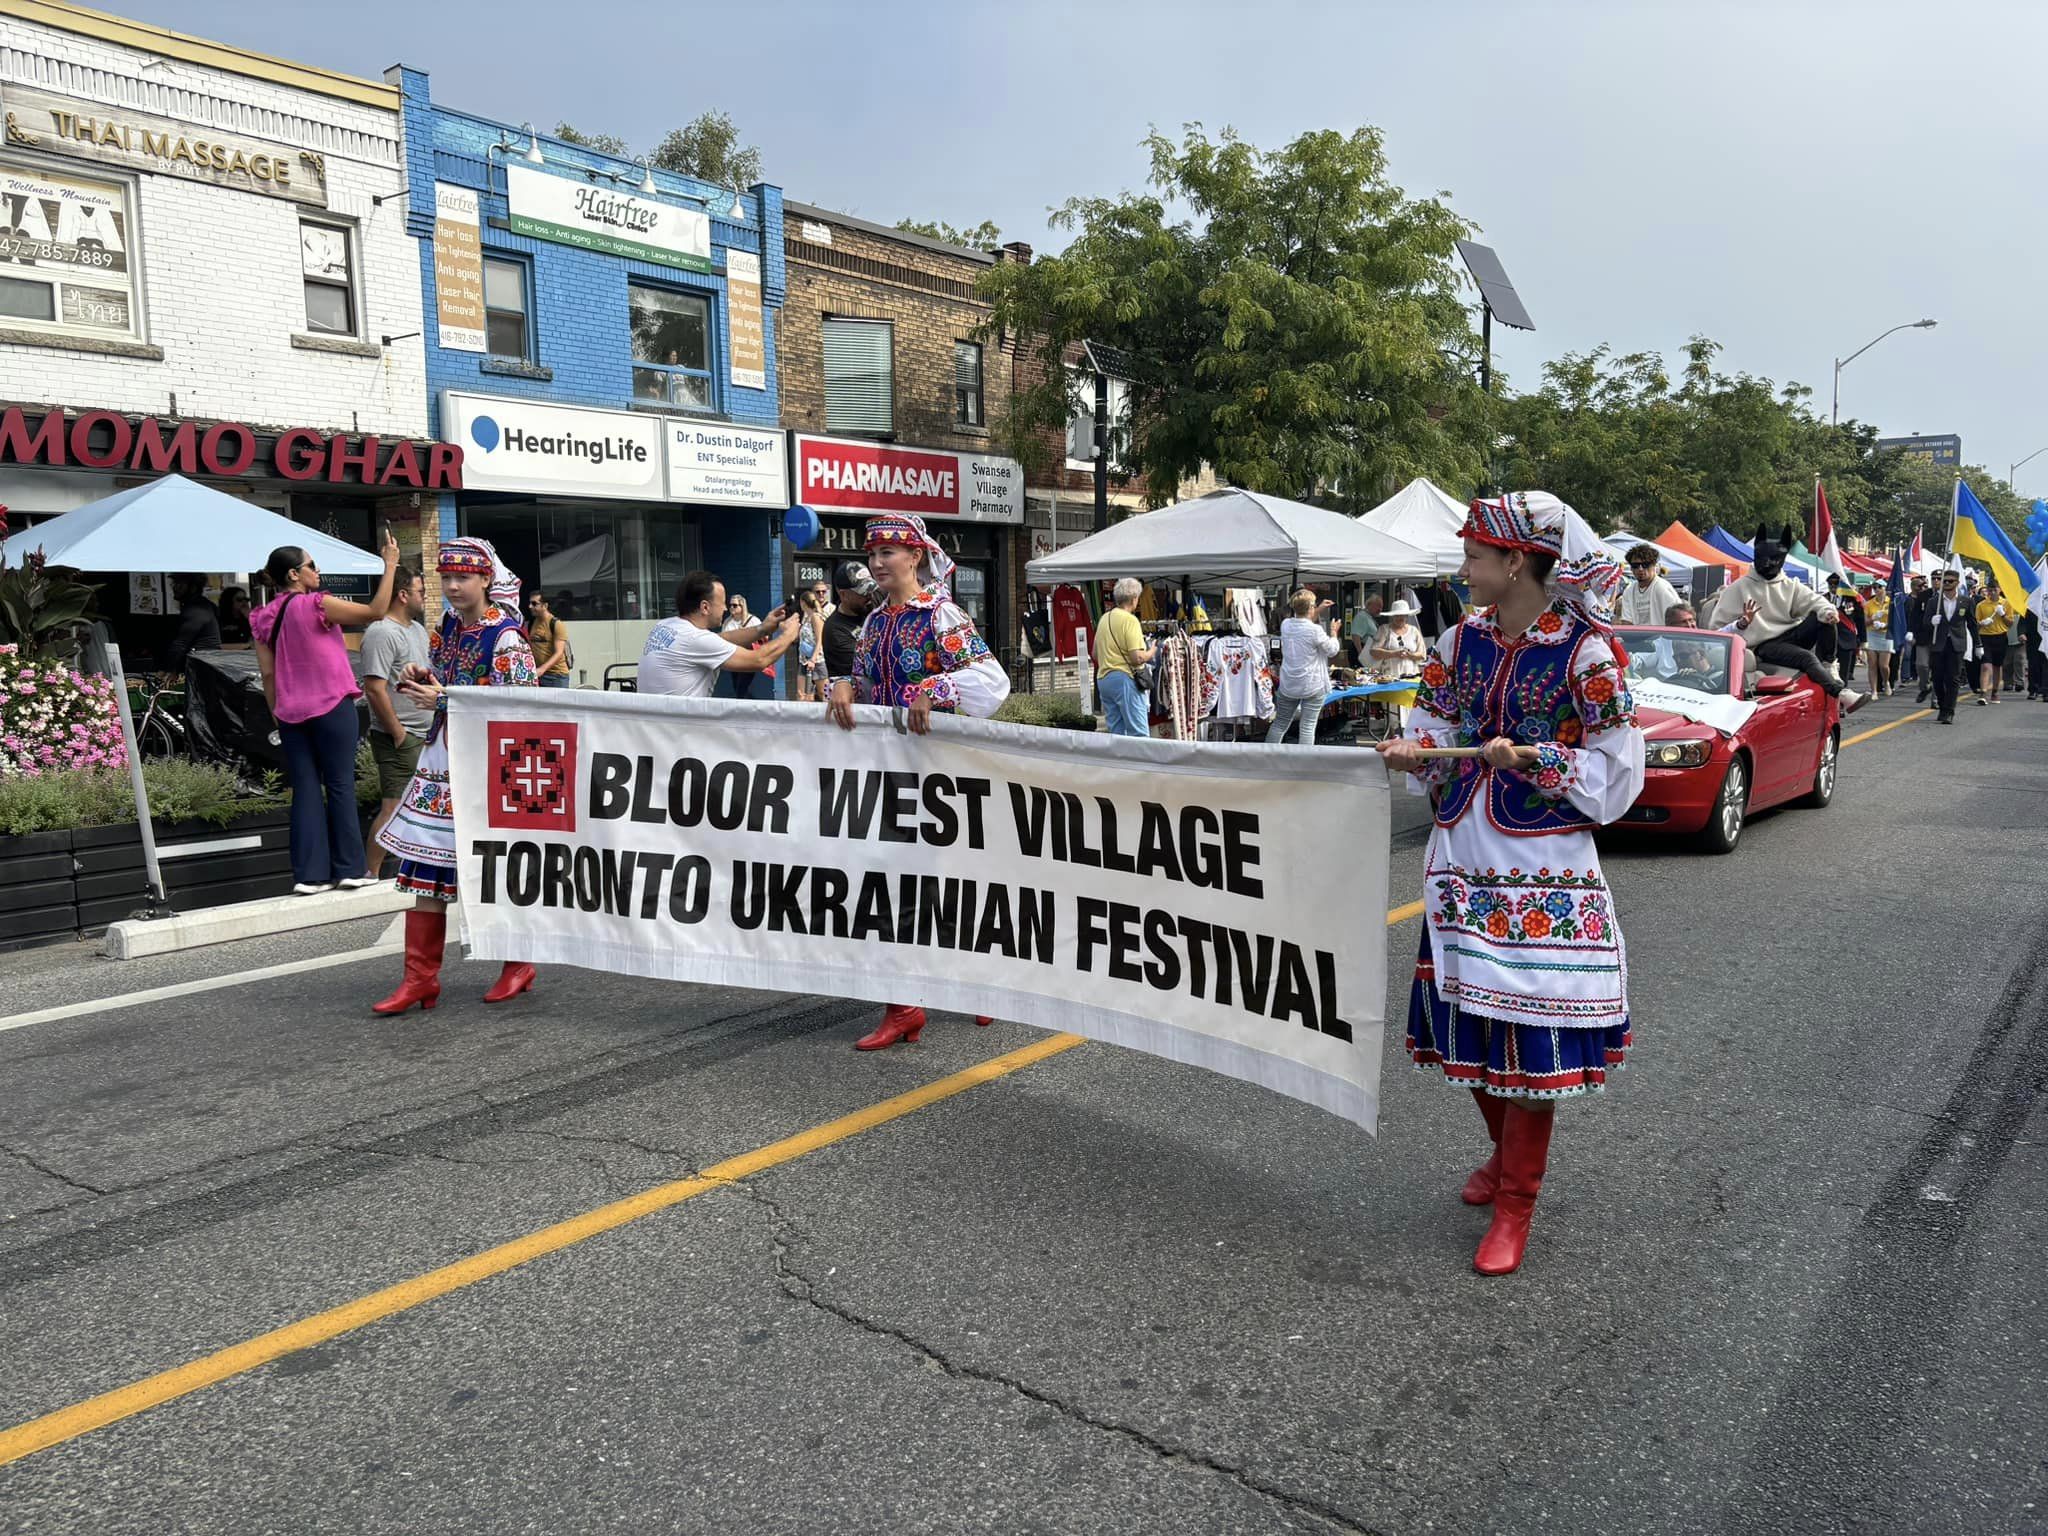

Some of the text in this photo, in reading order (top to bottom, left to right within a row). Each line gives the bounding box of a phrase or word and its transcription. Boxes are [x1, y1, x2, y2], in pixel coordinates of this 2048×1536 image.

[49, 109, 290, 184] THAI MASSAGE
[157, 159, 201, 176] BY RMT
[7, 179, 111, 207] Wellness Mountain
[575, 188, 658, 227] Hairfree
[582, 210, 602, 222] Laser
[437, 223, 474, 242] Hair loss
[434, 241, 448, 254] Skin
[518, 220, 706, 267] Hair loss Anti aging Skin tightening Laser hair removal
[437, 261, 480, 284] Anti aging
[439, 282, 481, 301] Laser Hair
[442, 301, 477, 317] Removal
[0, 406, 465, 490] MOMO GHAR
[503, 426, 647, 465] HearingLife
[677, 430, 774, 453] Dr. Dustin Dalgorf
[697, 452, 757, 466] ENT Specialist
[807, 457, 954, 499] PHARMASAVE
[971, 462, 1011, 479] Swansea
[704, 475, 752, 488] Otolaryngology
[976, 480, 1008, 498] Village
[693, 485, 764, 498] Head and Neck Surgery
[970, 499, 1013, 517] Pharmacy
[801, 567, 824, 581] 2388
[589, 751, 1264, 899] BLOOR WEST VILLAGE
[472, 840, 1353, 1044] TORONTO UKRAINIAN FESTIVAL
